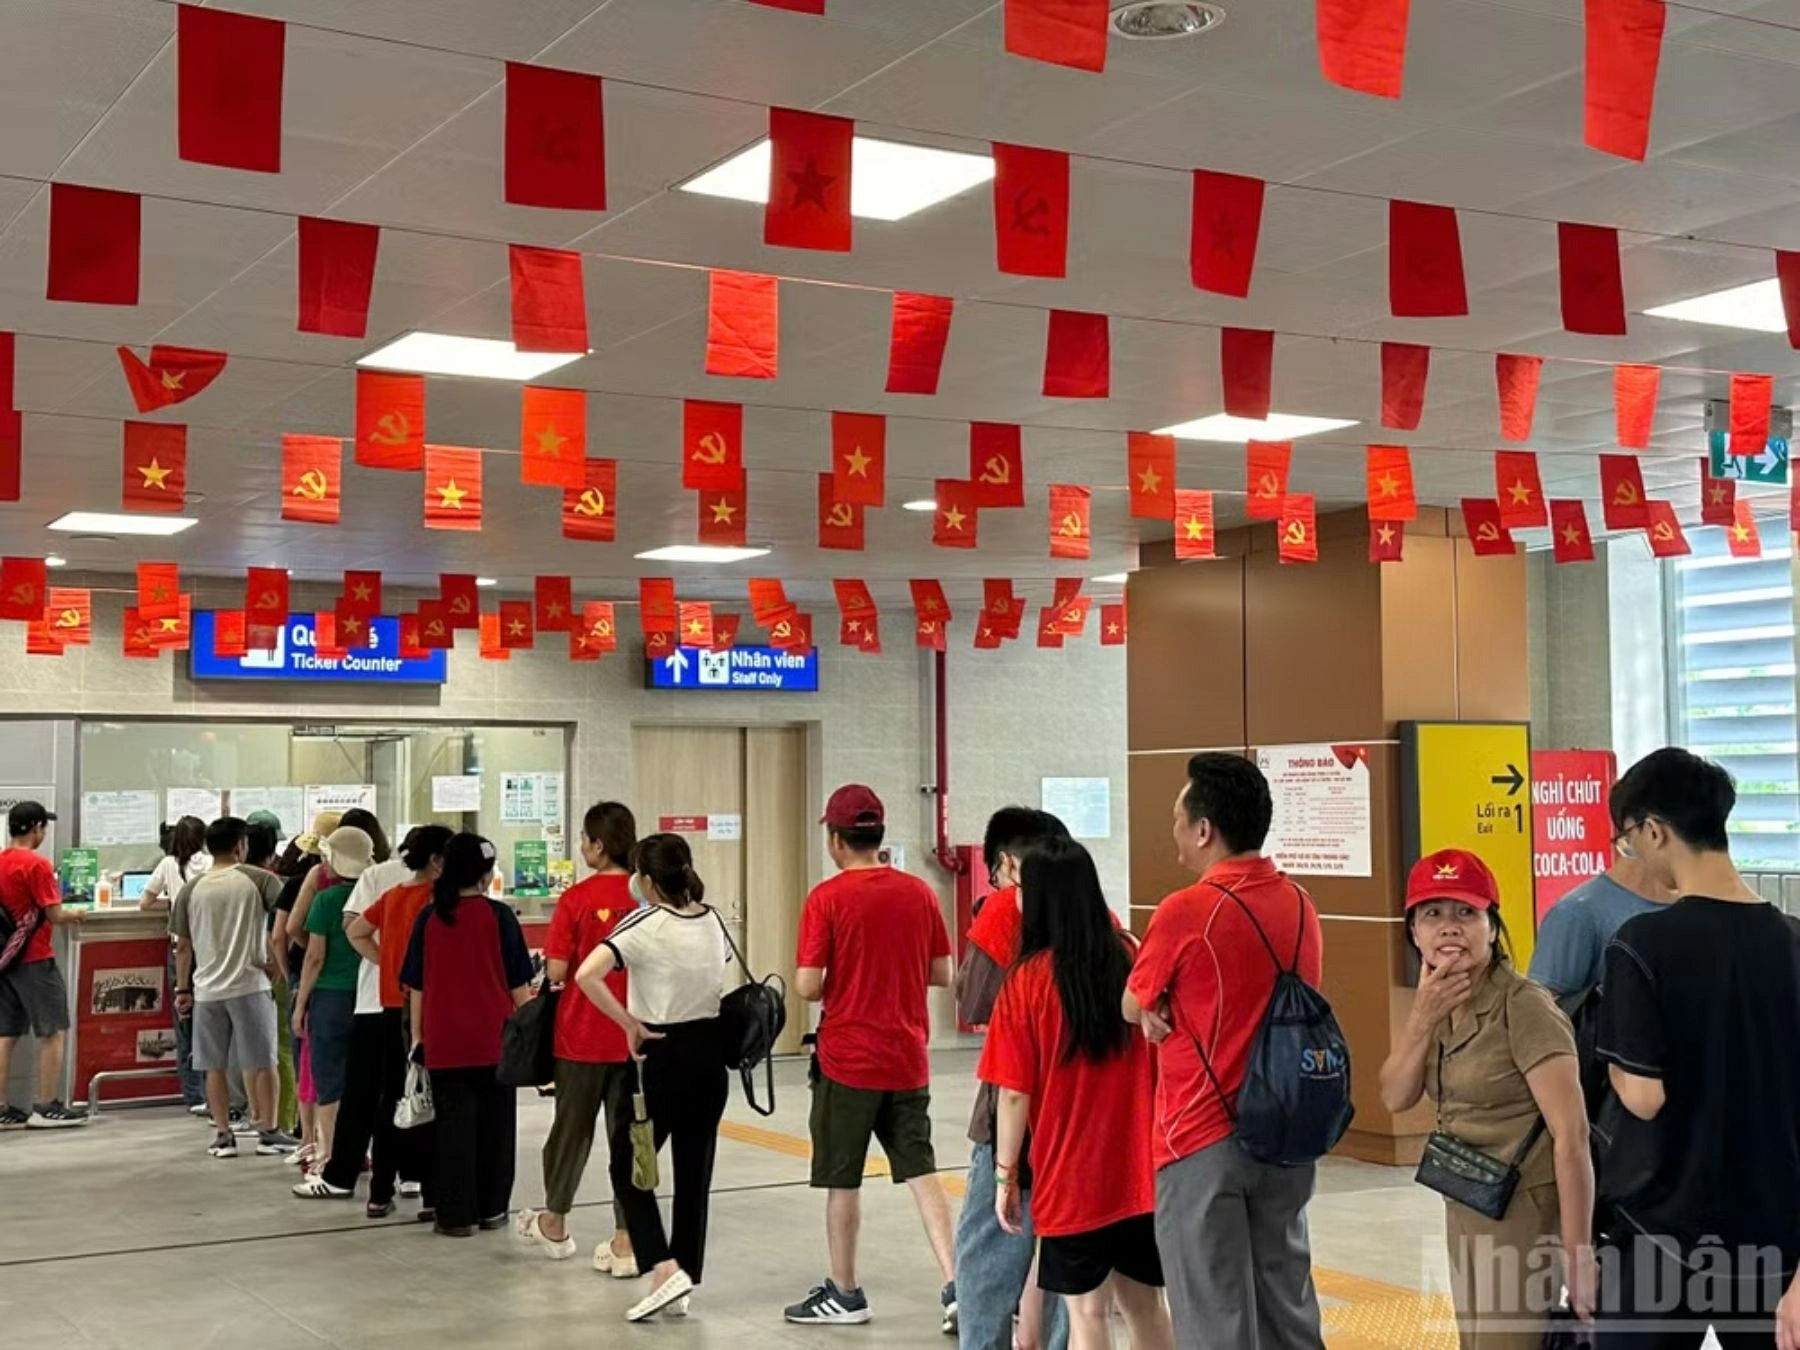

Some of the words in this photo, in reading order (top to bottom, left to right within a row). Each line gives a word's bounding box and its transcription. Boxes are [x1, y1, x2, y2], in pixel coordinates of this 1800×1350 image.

[342, 655, 402, 672] Counter
[731, 651, 771, 668] Nhân
[732, 671, 757, 684] Staff
[758, 672, 783, 687] Only
[1531, 773, 1563, 804] NGHỈ
[1566, 774, 1601, 804] CHÚT
[1498, 806, 1511, 817] ra
[1477, 823, 1493, 834] Exit
[1546, 807, 1585, 840] UỐNG
[1534, 851, 1606, 877] COCA-COLA
